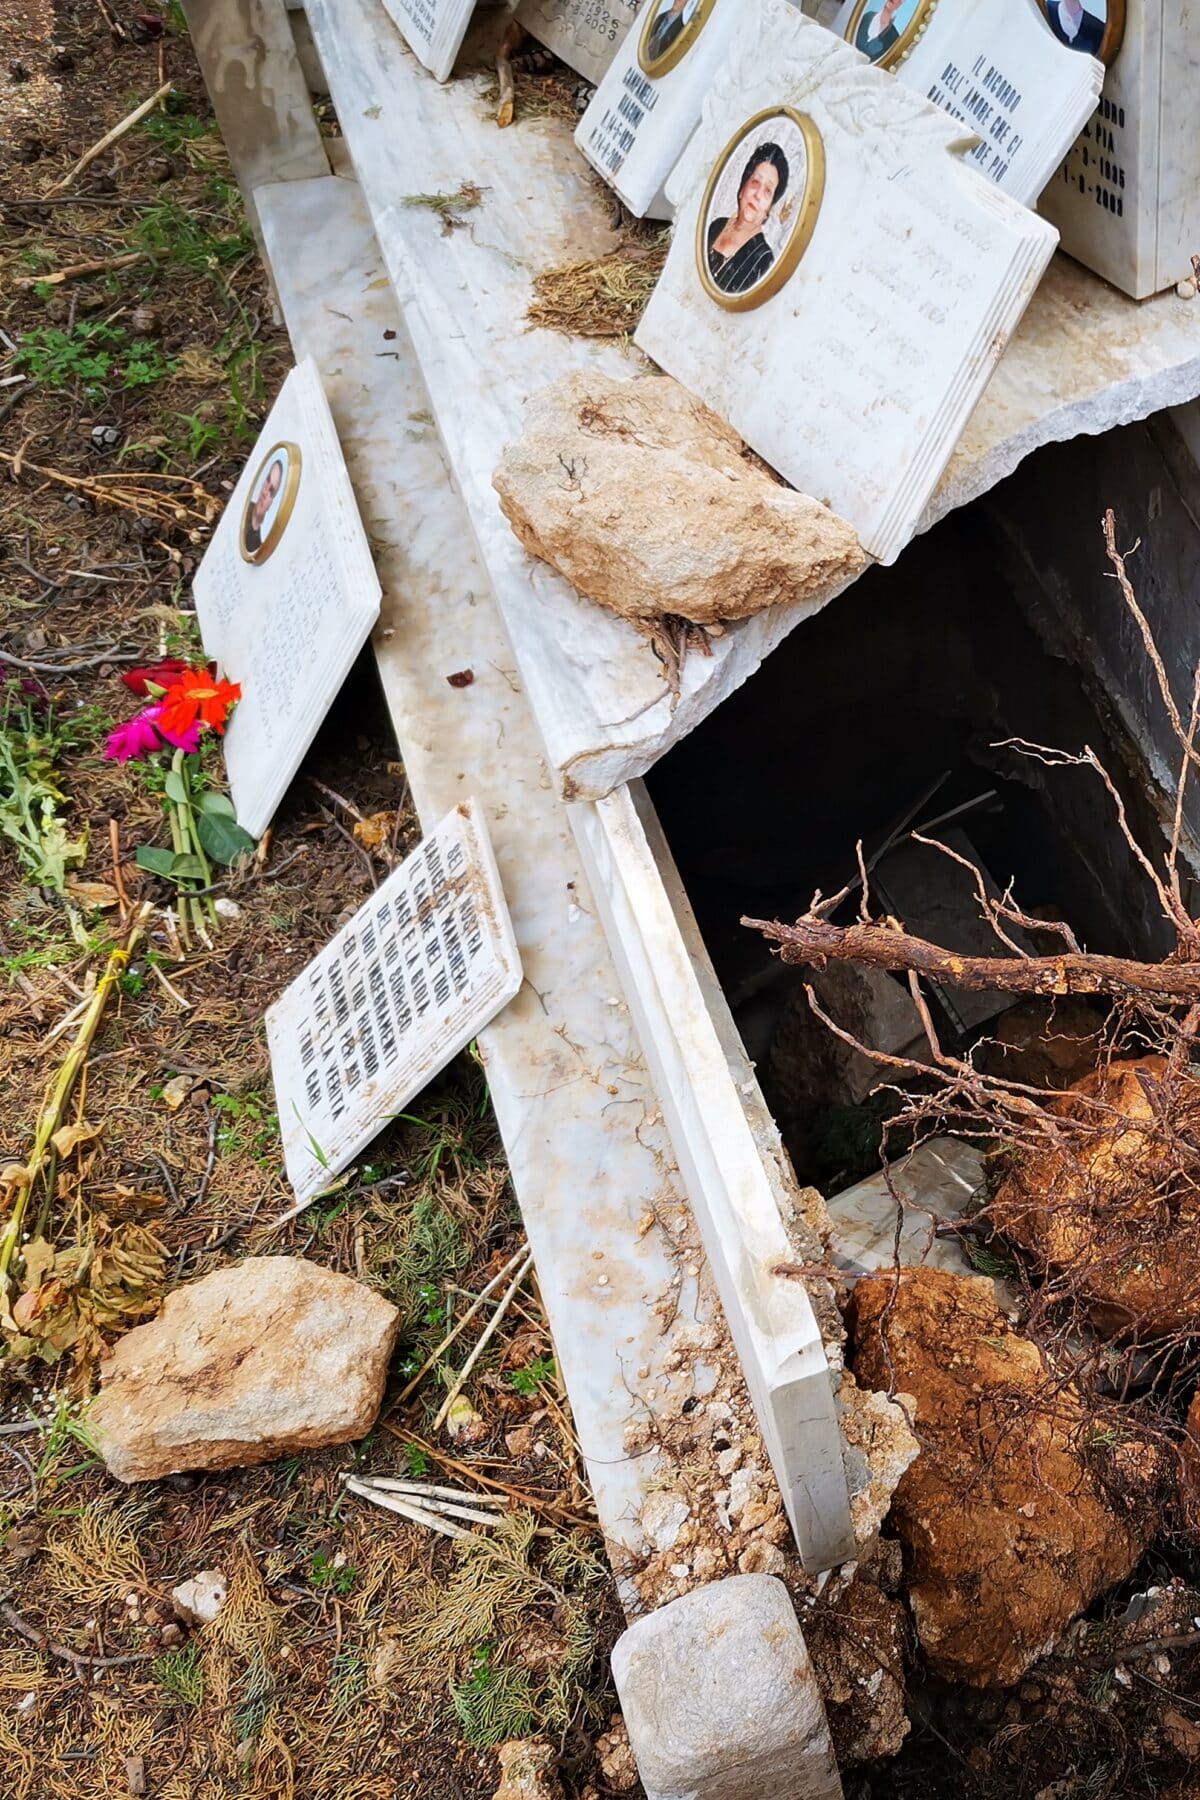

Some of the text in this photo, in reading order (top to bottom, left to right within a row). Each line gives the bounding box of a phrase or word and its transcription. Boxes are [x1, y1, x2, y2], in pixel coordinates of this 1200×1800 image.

[971, 54, 1022, 114] IL RICORDO
[961, 86, 994, 126] AMORE
[989, 115, 1012, 145] CHE
[1006, 135, 1024, 157] CI
[408, 857, 422, 881] IL
[394, 890, 413, 930] BACI
[434, 889, 451, 914] CI
[447, 843, 463, 874] SEI
[459, 895, 483, 959] NOSTRA
[360, 920, 377, 959] TUOI
[405, 942, 420, 969] LA
[425, 936, 441, 967] DEI
[309, 965, 322, 990] LA
[376, 902, 412, 1034] DEL TUO SORRISO
[432, 965, 451, 1008] TUOI
[313, 989, 327, 1021] VIA
[328, 959, 349, 1028] SARANNO
[340, 1028, 355, 1061] PER
[343, 935, 379, 1079] ED IL TUO RICORDO
[367, 957, 398, 1068] INSEGNAMENTI
[411, 968, 431, 1018] GIOIA
[300, 1029, 315, 1069] TUOI
[320, 1034, 334, 1061] LA
[306, 1069, 321, 1110] CARI
